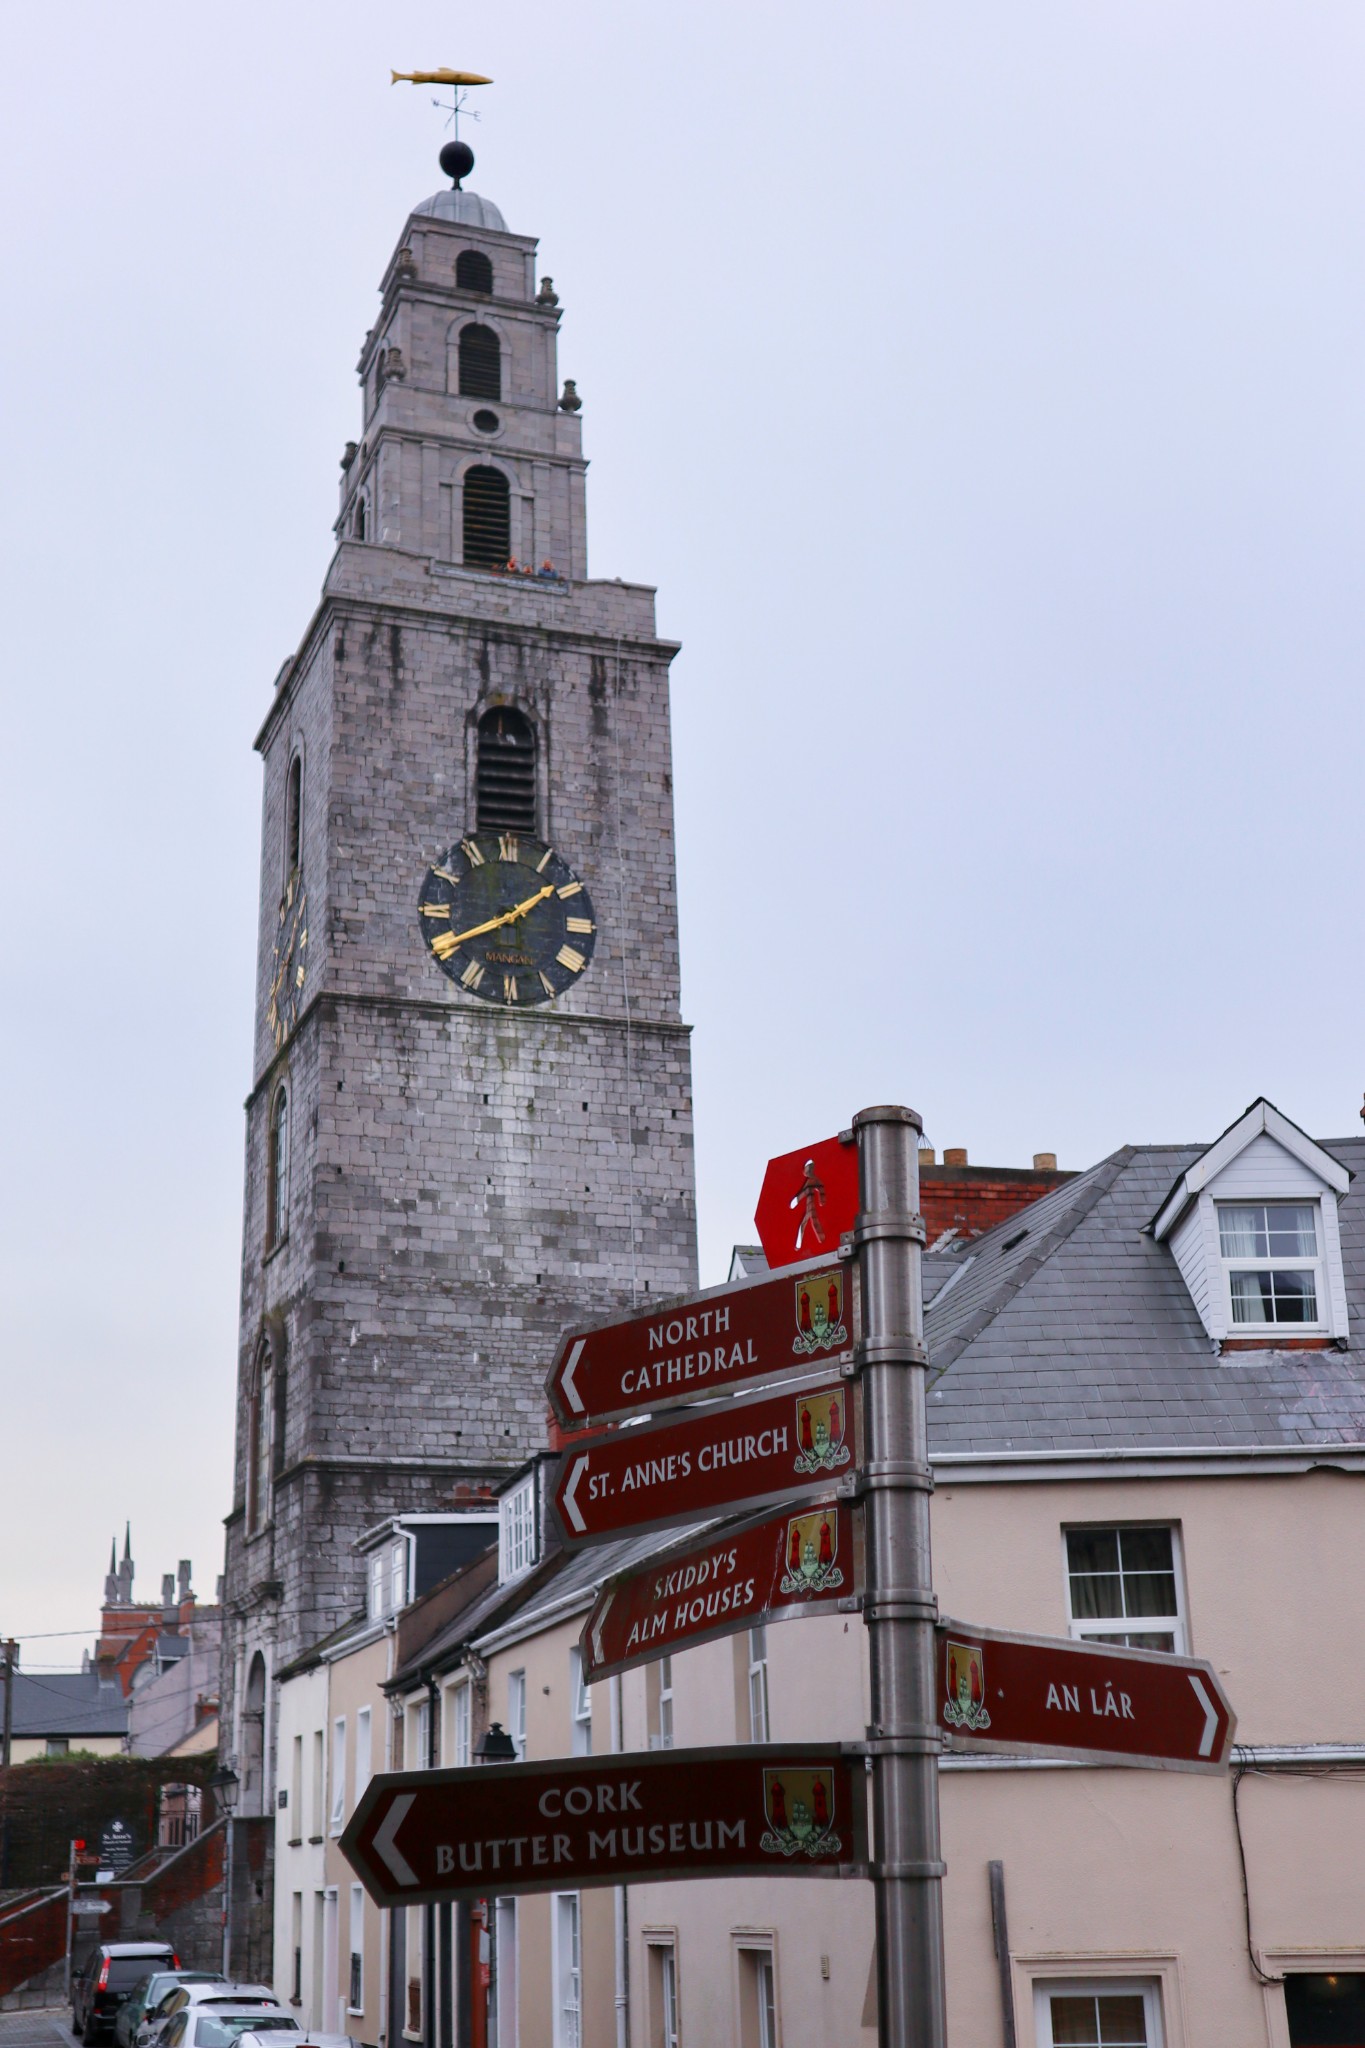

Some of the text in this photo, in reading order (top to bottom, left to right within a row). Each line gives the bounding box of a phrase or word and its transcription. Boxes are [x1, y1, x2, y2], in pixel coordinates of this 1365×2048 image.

[648, 1306, 730, 1351] NORTH
[620, 1338, 758, 1394] CATHEDRAL
[588, 1472, 615, 1500] ST.
[620, 1451, 692, 1492] ANNE'S
[697, 1426, 788, 1472] CHURCH
[655, 1548, 737, 1599] SKIDDY'S
[626, 1610, 668, 1647] ALM
[674, 1578, 755, 1629] HOUSES
[1045, 1681, 1136, 1720] AN LÁR
[538, 1781, 643, 1818] CORK
[436, 1834, 574, 1874] BUTTER
[588, 1819, 746, 1860] MUSEUM
